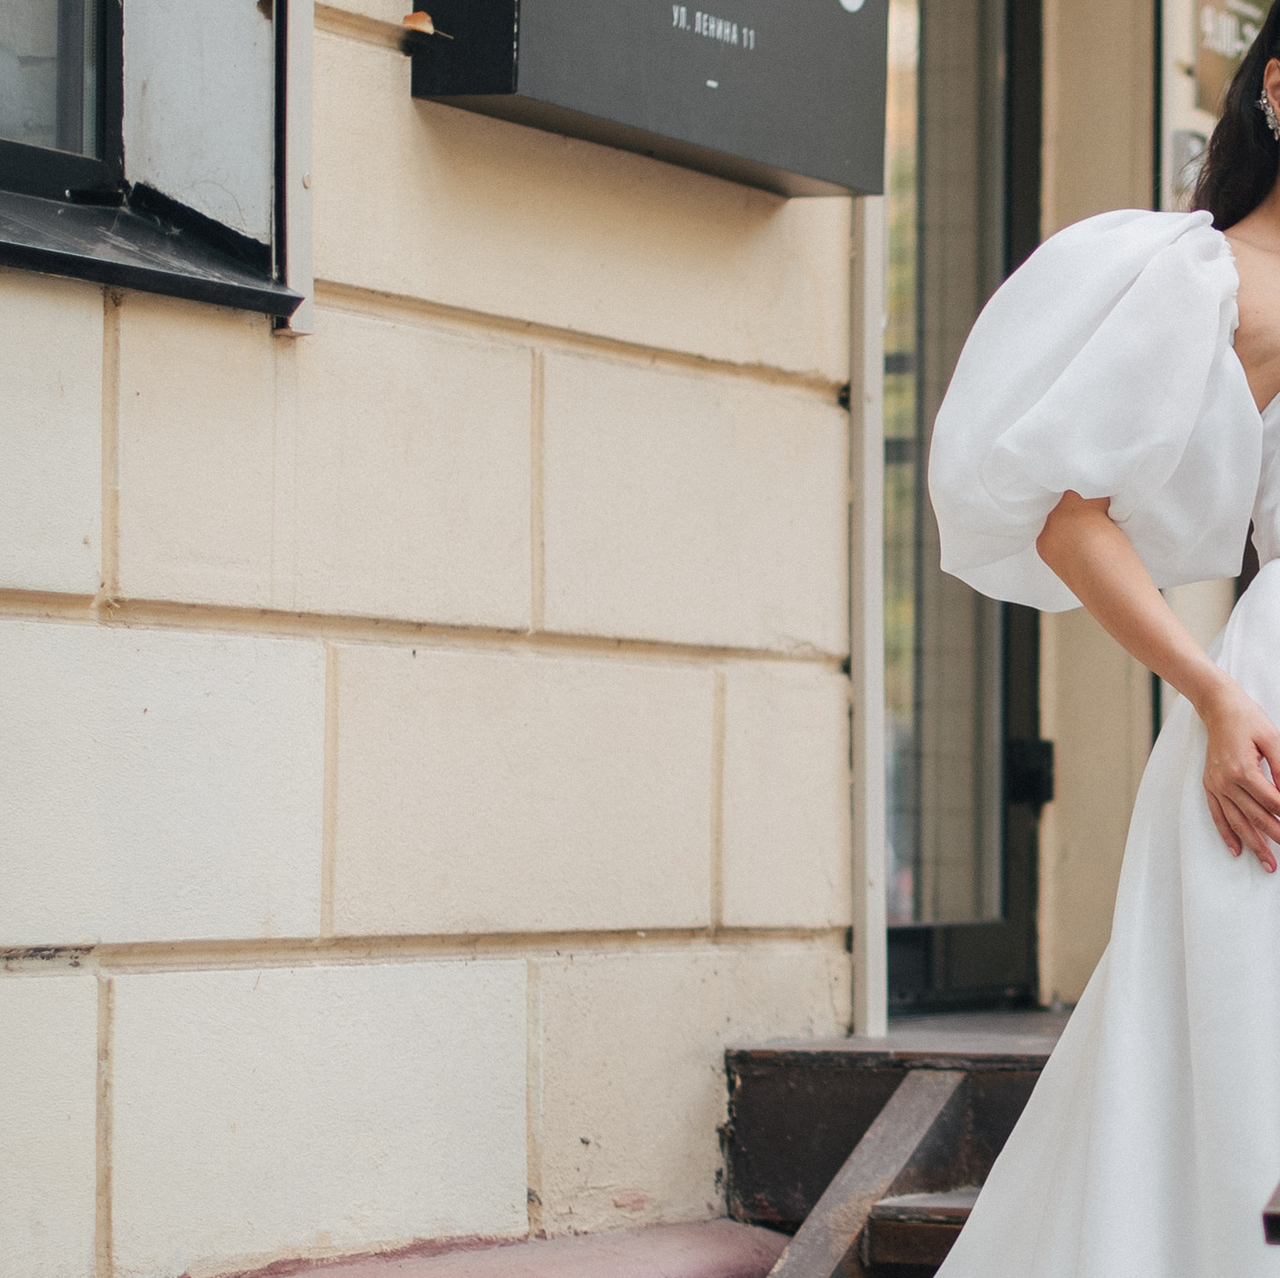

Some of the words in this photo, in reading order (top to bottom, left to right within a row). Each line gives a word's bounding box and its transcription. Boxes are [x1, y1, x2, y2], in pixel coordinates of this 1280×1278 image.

[672, 4, 691, 31] УЛ.
[694, 11, 738, 46] ЛЕНИНА
[742, 27, 755, 51] 11
